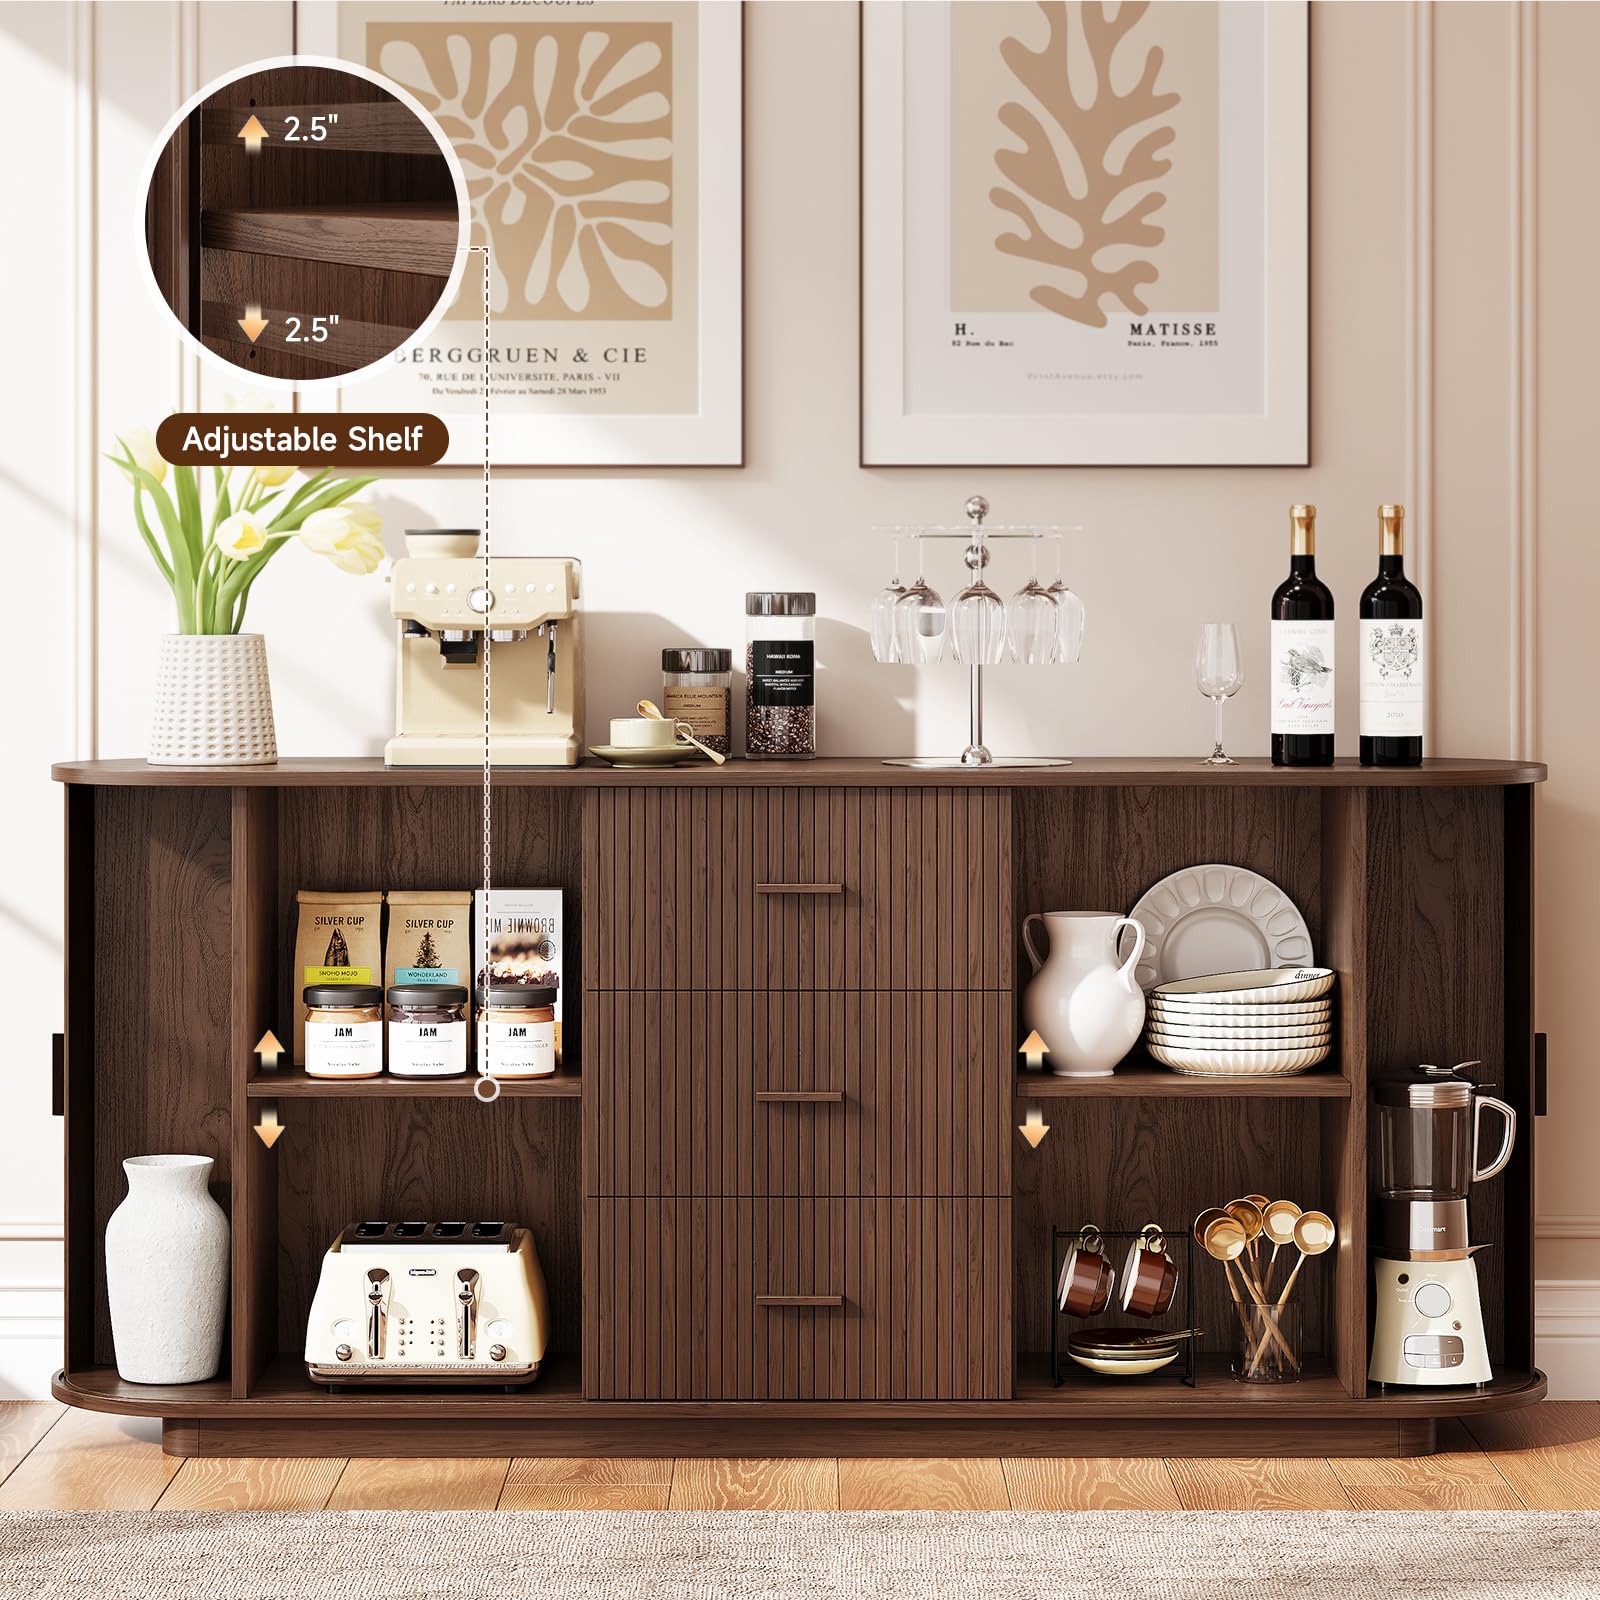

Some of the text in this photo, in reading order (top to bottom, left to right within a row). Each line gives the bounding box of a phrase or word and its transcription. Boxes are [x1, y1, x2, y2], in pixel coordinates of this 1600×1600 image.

[954, 323, 1217, 336] H. MATISSE
[572, 347, 589, 363] &
[603, 347, 648, 363] CIE
[436, 373, 459, 381] RUE
[462, 373, 476, 381] DE
[480, 373, 560, 382] LUNIVERSITE,
[563, 373, 594, 381] PARIS
[604, 373, 621, 381] VII
[314, 916, 365, 926] SILVER CUP
[405, 919, 455, 929] SILVER CUP
[1294, 969, 1321, 980] dinner
[334, 1027, 353, 1037] JAM
[418, 1027, 438, 1037] JAM
[508, 1027, 527, 1037] JAM
